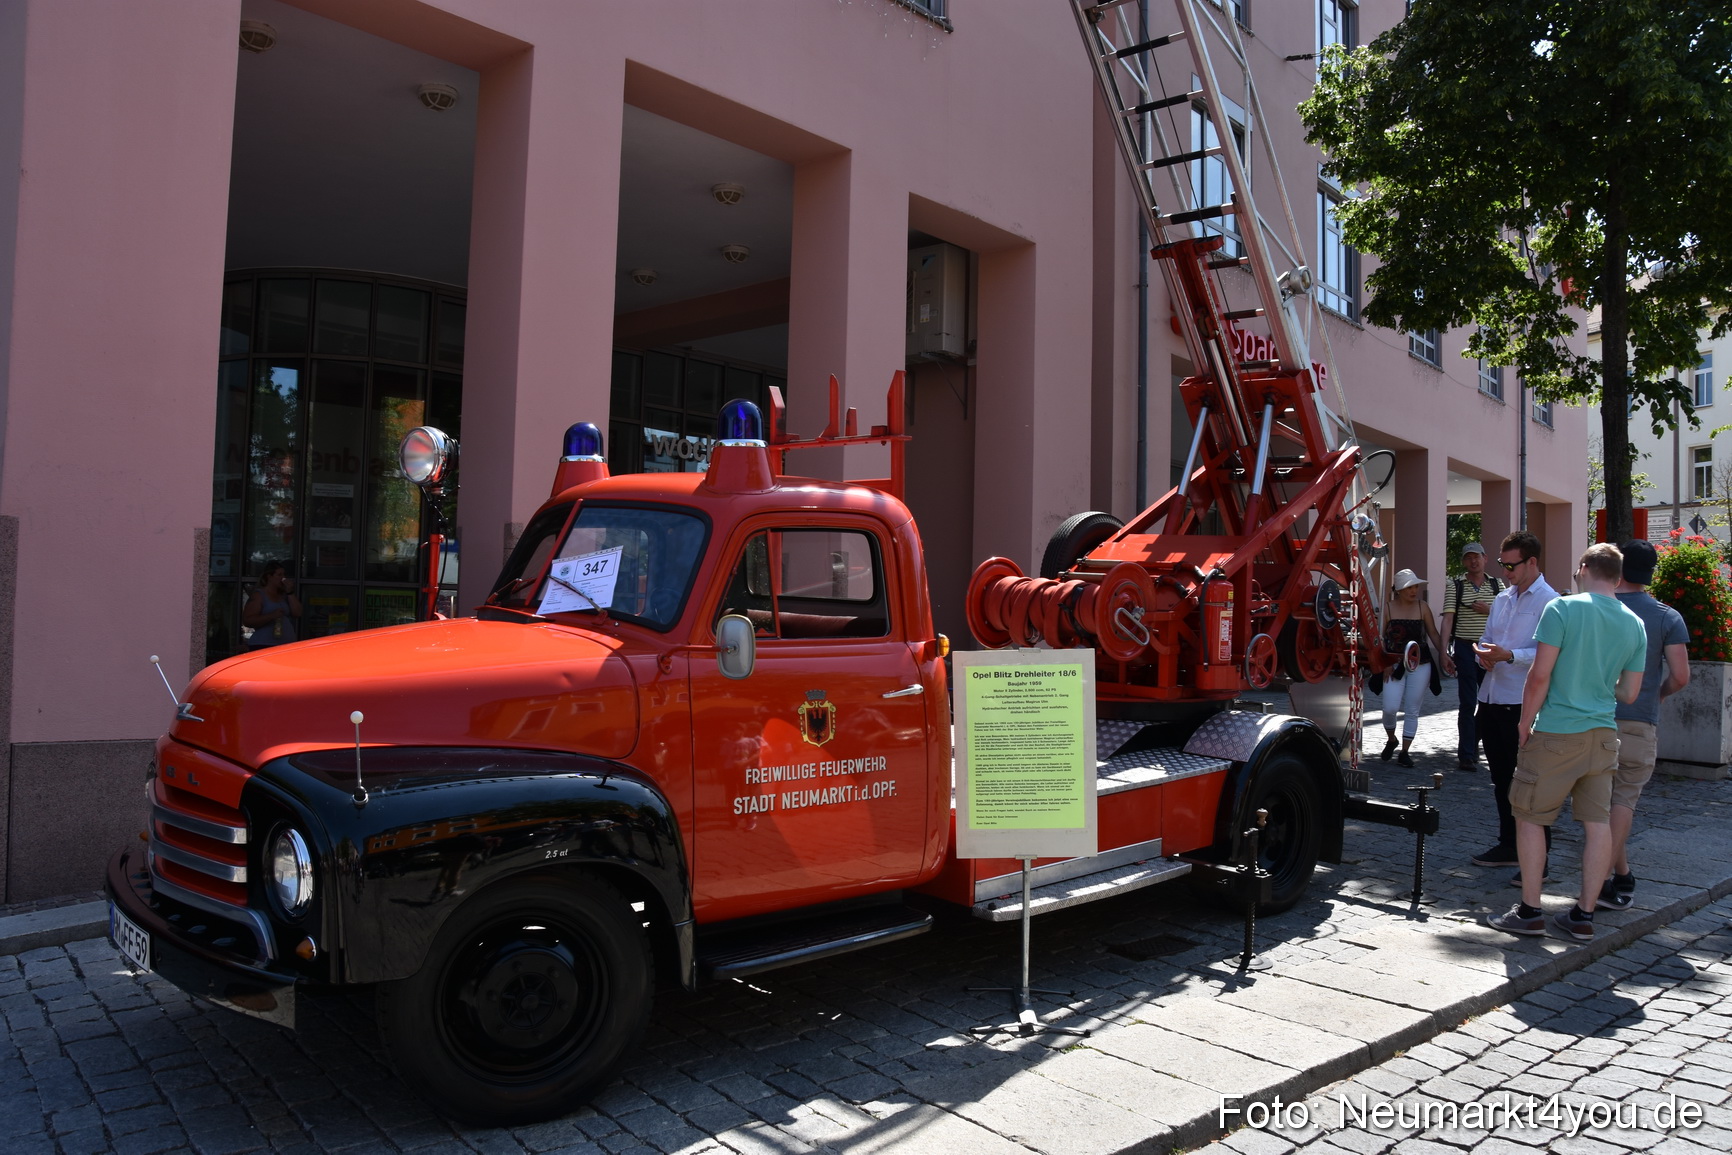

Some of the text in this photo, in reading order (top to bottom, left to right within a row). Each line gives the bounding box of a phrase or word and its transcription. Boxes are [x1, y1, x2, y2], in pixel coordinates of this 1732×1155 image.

[582, 559, 609, 576] 347
[972, 671, 992, 680] Opel
[1014, 670, 1056, 678] Drehleiter
[745, 756, 887, 785] FREIWILLIGE FEUERWEHR
[733, 793, 776, 815] STADT
[781, 785, 853, 810] NEUMARKT
[545, 849, 558, 859] 2.5
